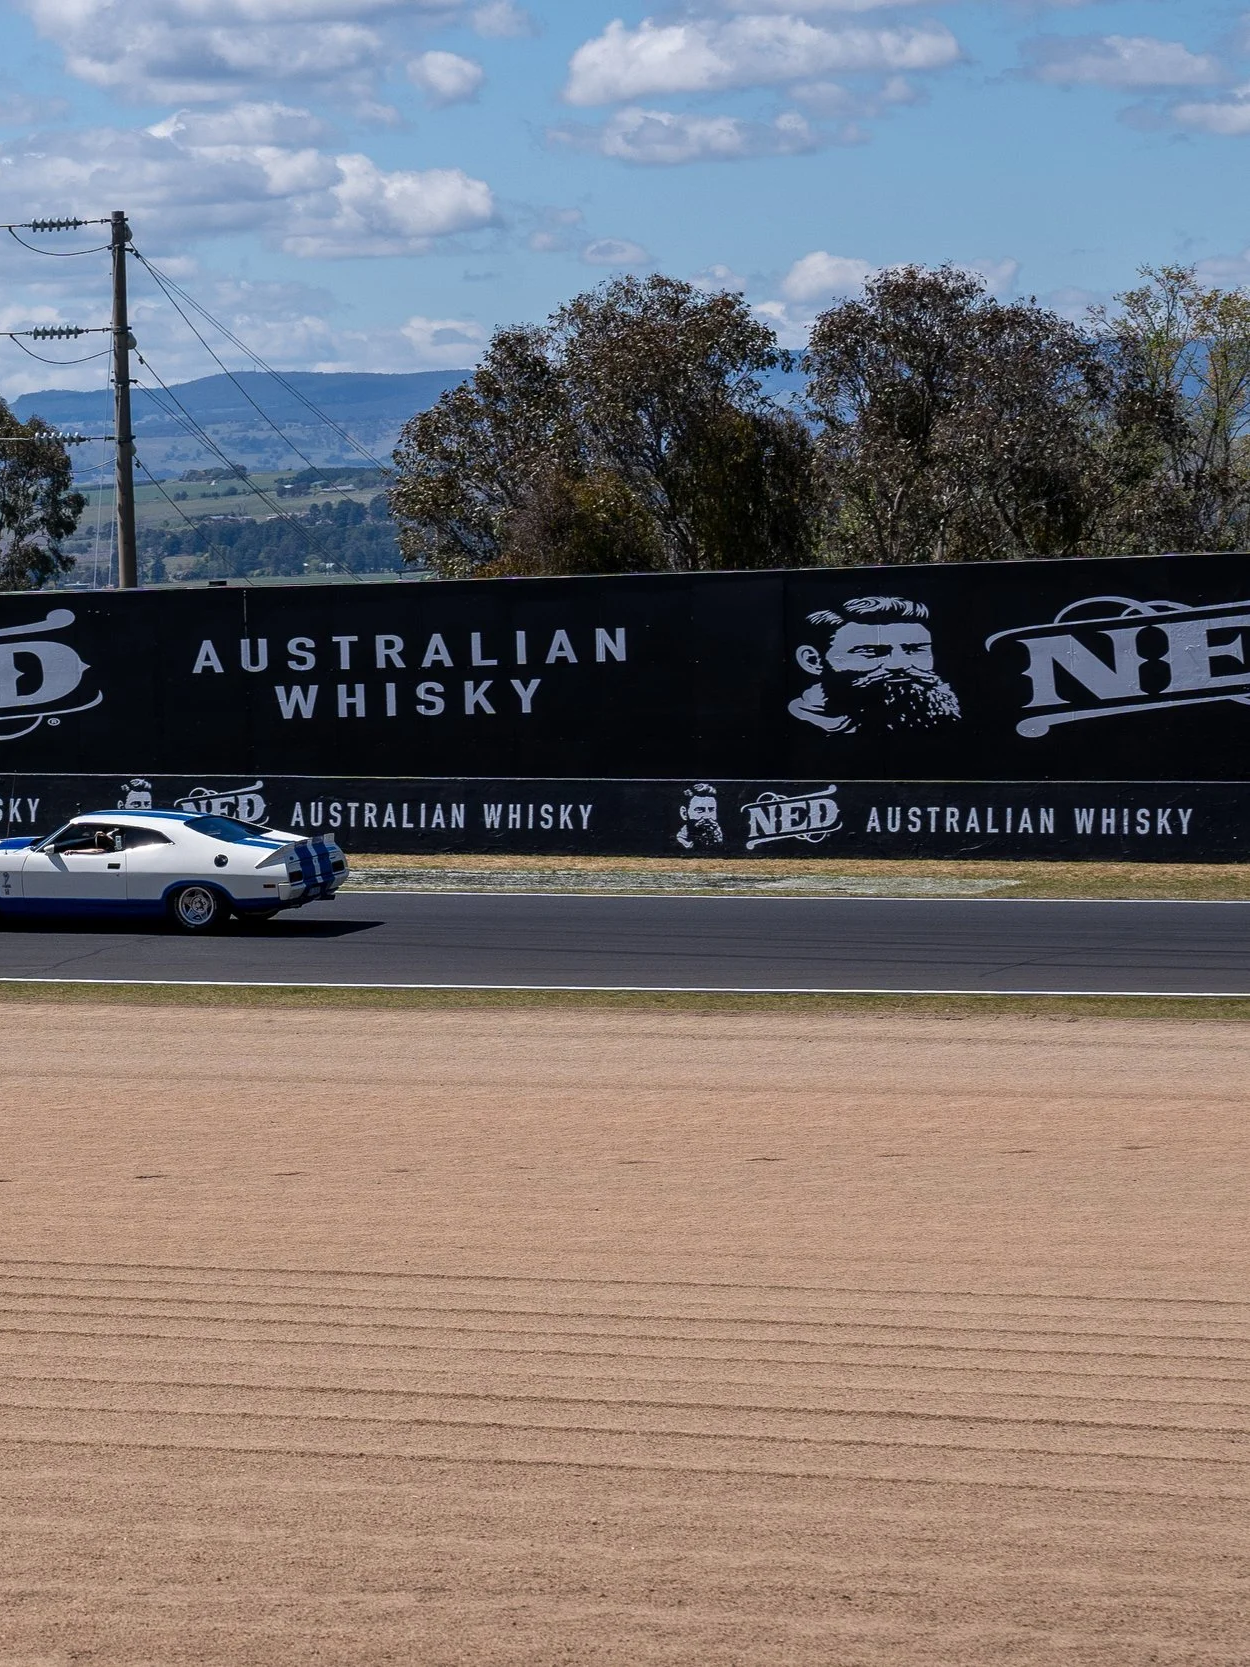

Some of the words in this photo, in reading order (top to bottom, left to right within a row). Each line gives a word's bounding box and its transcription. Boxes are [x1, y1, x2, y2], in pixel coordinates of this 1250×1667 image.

[193, 628, 627, 673] AUSTRALIAN
[1017, 615, 1250, 708] NE
[275, 679, 541, 719] WHISKY
[291, 802, 465, 829] AUSTRALIAN
[483, 804, 593, 830] WHISKY
[748, 799, 841, 838] NED
[867, 807, 1054, 834] AUSTRALIAN
[1074, 808, 1193, 835] WHISKY
